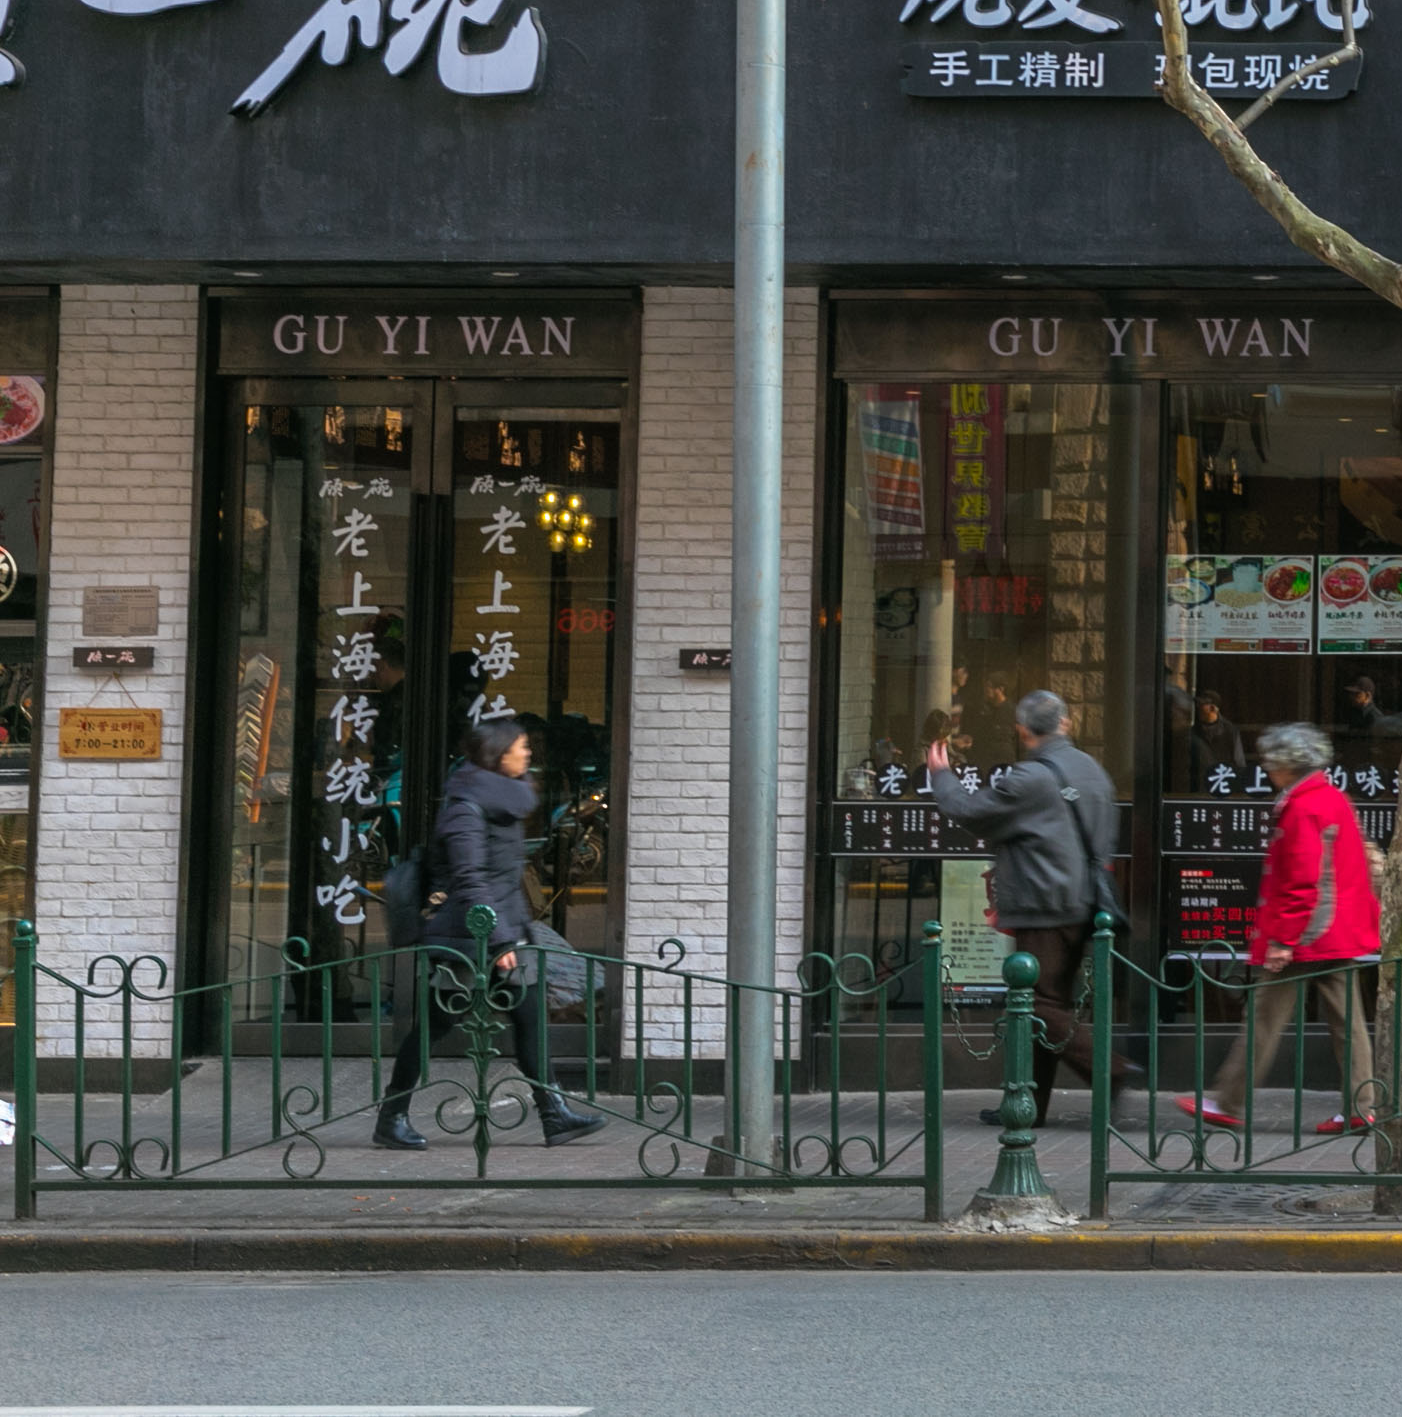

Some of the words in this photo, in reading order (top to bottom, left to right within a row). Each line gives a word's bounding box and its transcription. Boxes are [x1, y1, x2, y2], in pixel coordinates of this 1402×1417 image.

[930, 50, 1104, 88] 手工精制
[273, 315, 349, 356] GU
[375, 315, 430, 356] YI
[457, 315, 577, 356] WAN
[989, 318, 1062, 357] GU
[1102, 318, 1159, 357] YI
[1199, 318, 1315, 357] WAN
[316, 508, 381, 925] 老上海传统小吃
